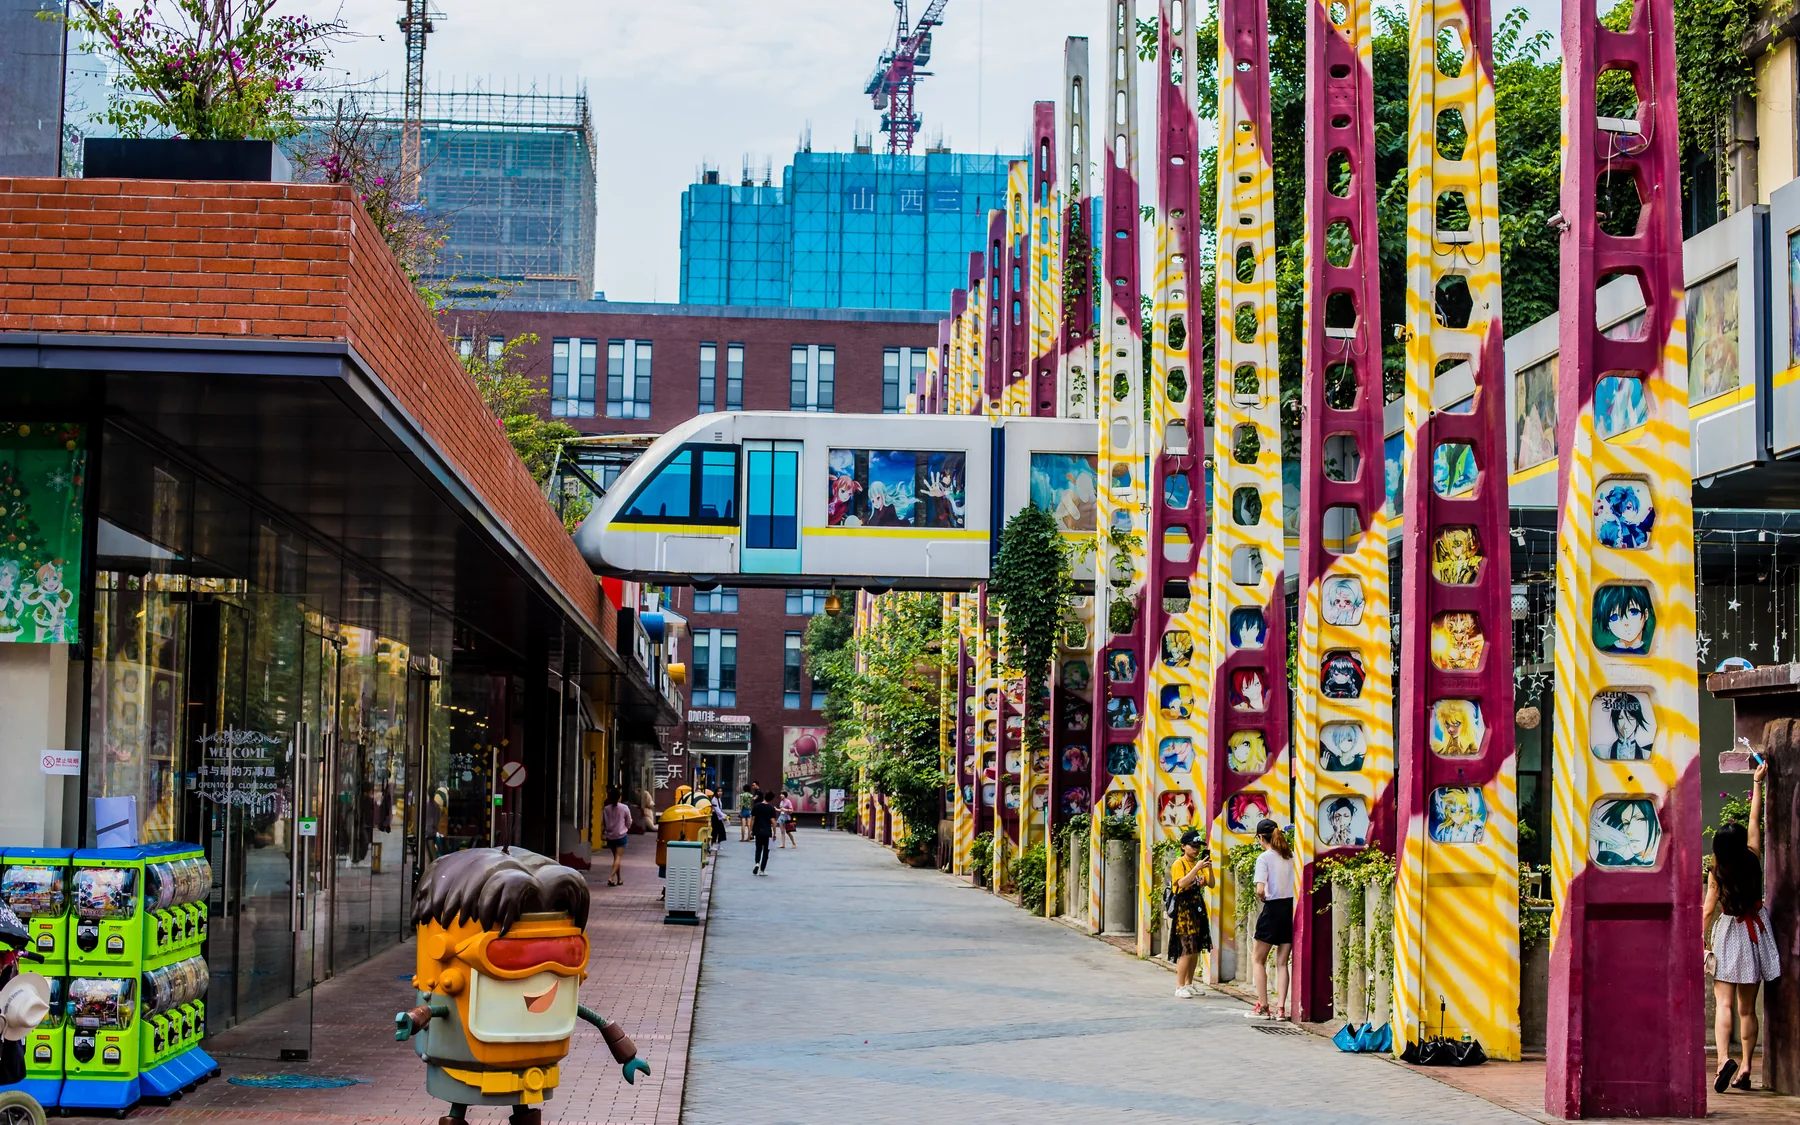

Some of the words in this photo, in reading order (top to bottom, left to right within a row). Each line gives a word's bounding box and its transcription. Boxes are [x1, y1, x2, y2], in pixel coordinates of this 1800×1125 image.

[852, 187, 1008, 213] 山西三
[688, 710, 715, 722] 咖啡
[209, 747, 268, 758] WELCOME
